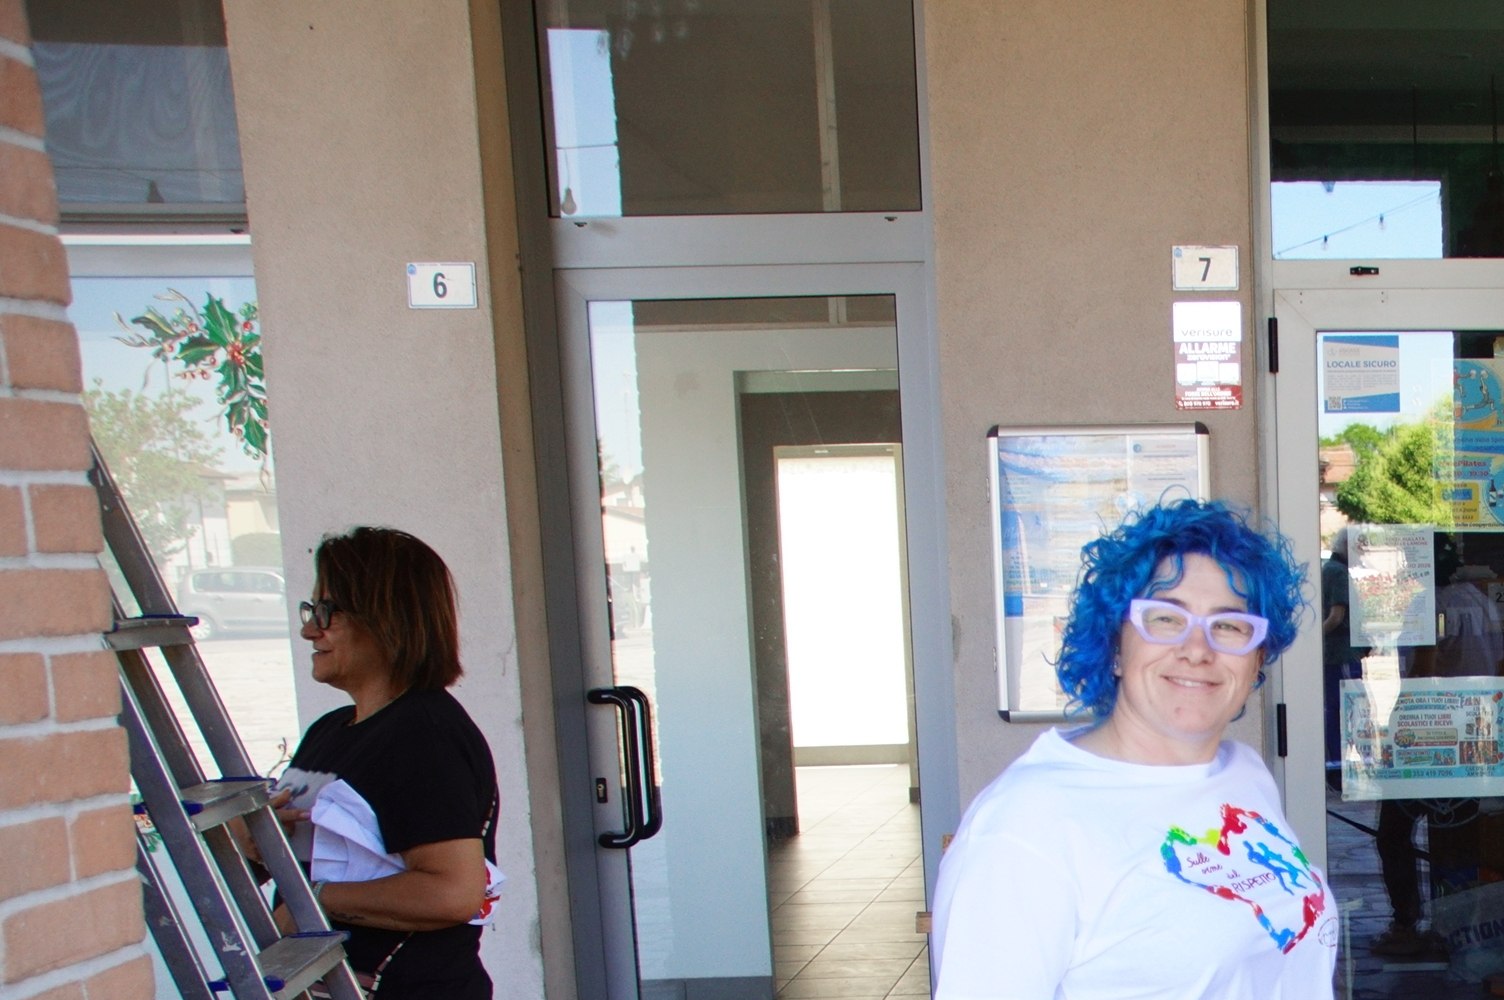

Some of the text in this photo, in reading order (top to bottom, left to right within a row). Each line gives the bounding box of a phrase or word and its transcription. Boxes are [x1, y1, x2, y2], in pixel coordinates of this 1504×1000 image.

[1199, 257, 1211, 282] 7
[433, 272, 448, 299] 6
[1181, 328, 1233, 337] verisure
[1179, 342, 1236, 354] ALLARME
[1327, 360, 1397, 369] LOCALE SICURO
[1231, 872, 1276, 893] RISPETTO
